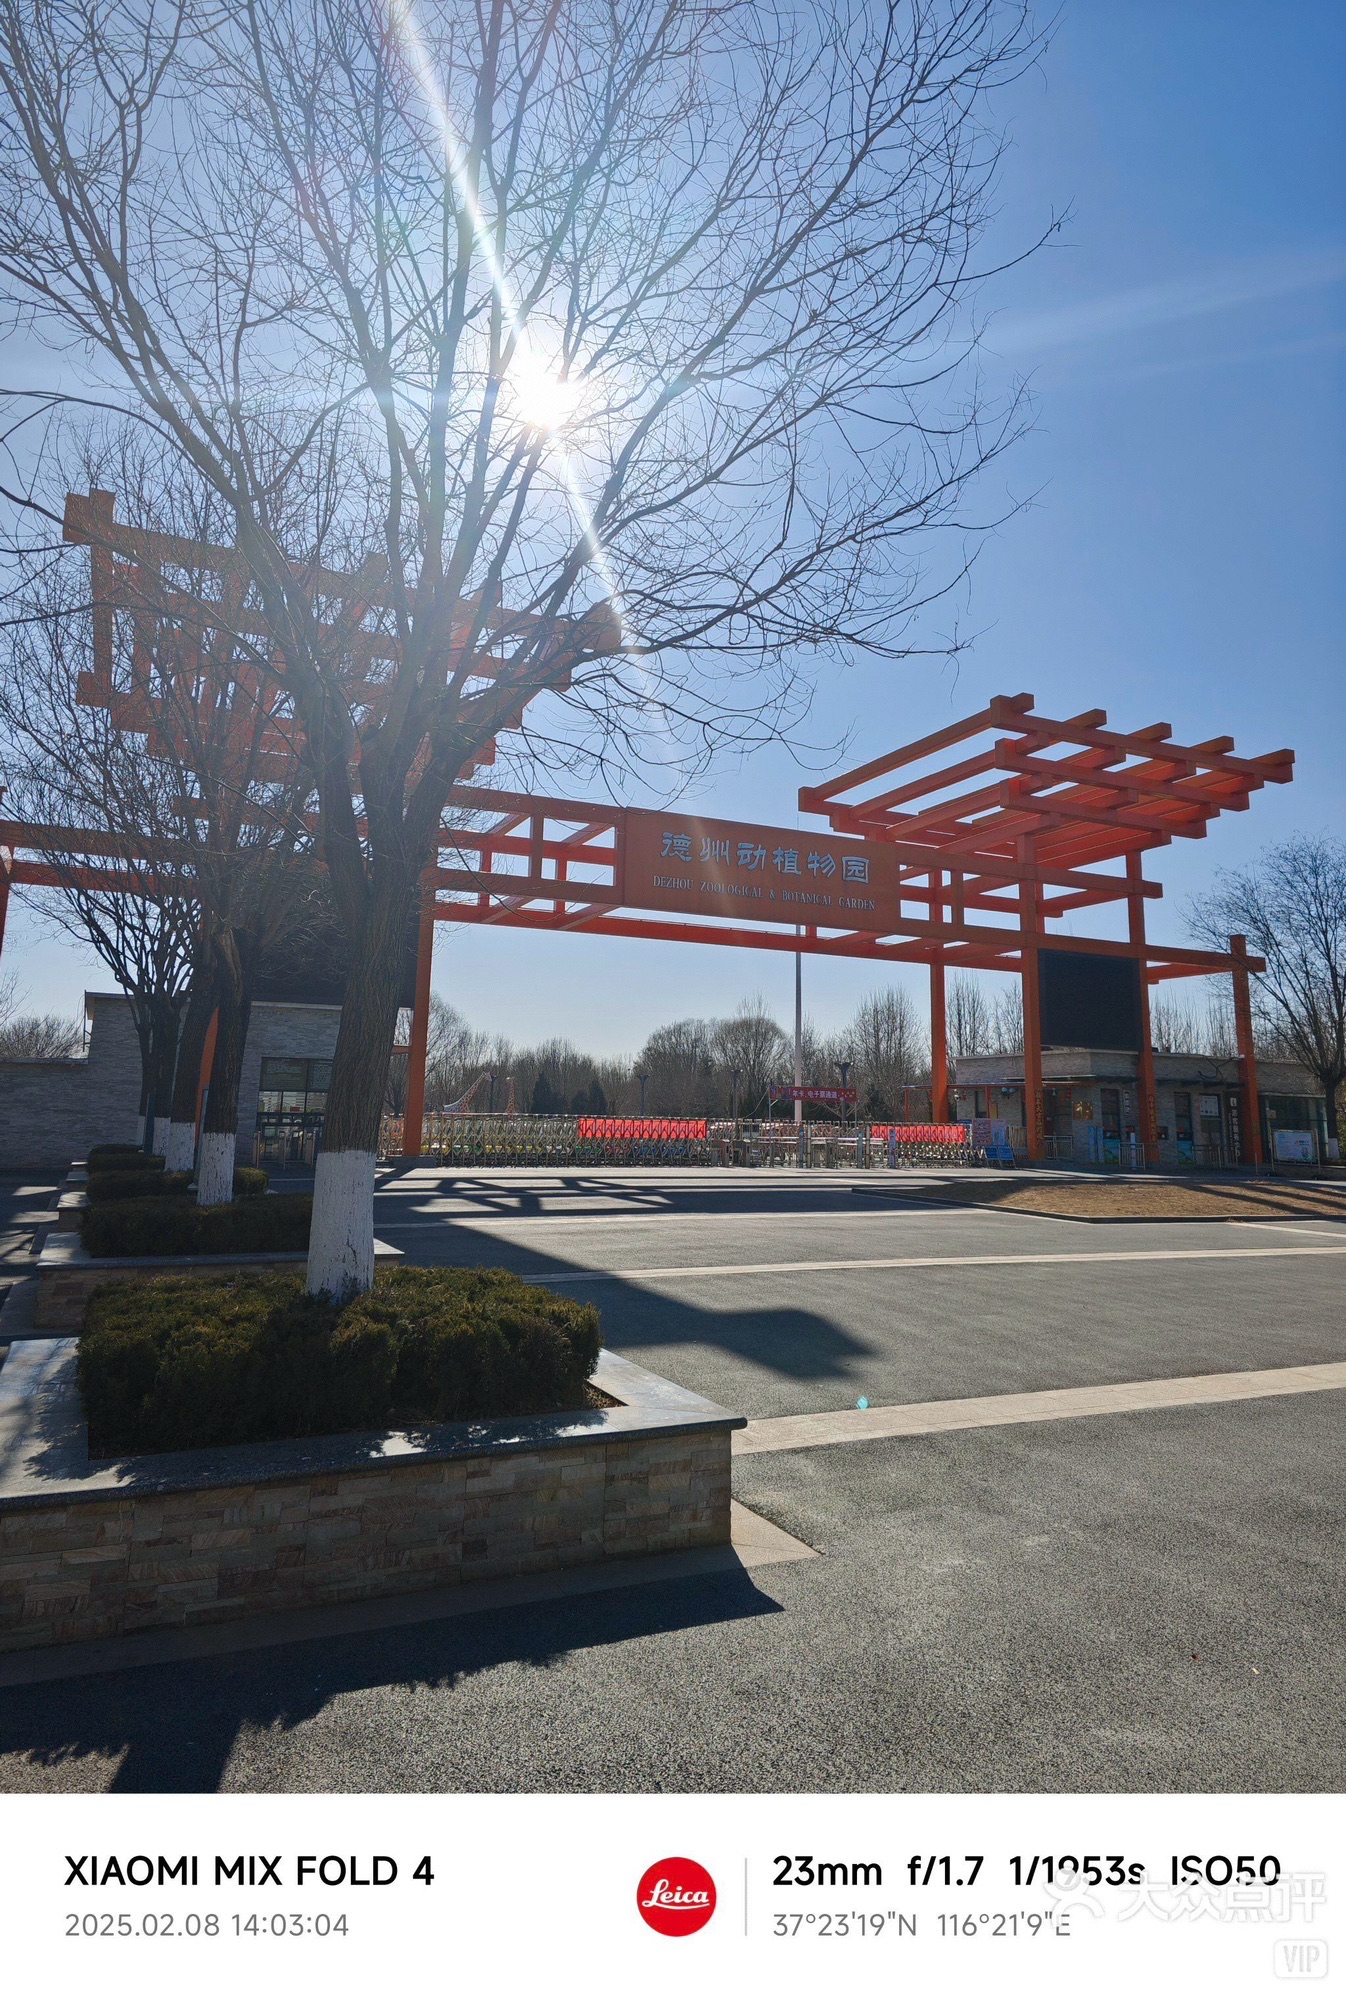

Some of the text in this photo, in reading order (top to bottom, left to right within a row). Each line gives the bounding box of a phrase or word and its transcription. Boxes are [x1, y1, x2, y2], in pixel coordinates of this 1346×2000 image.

[660, 831, 870, 884] 德州动植物园
[653, 875, 876, 911] DEZHOU ZOOLOGICAL & BOTANICAL GARDEN
